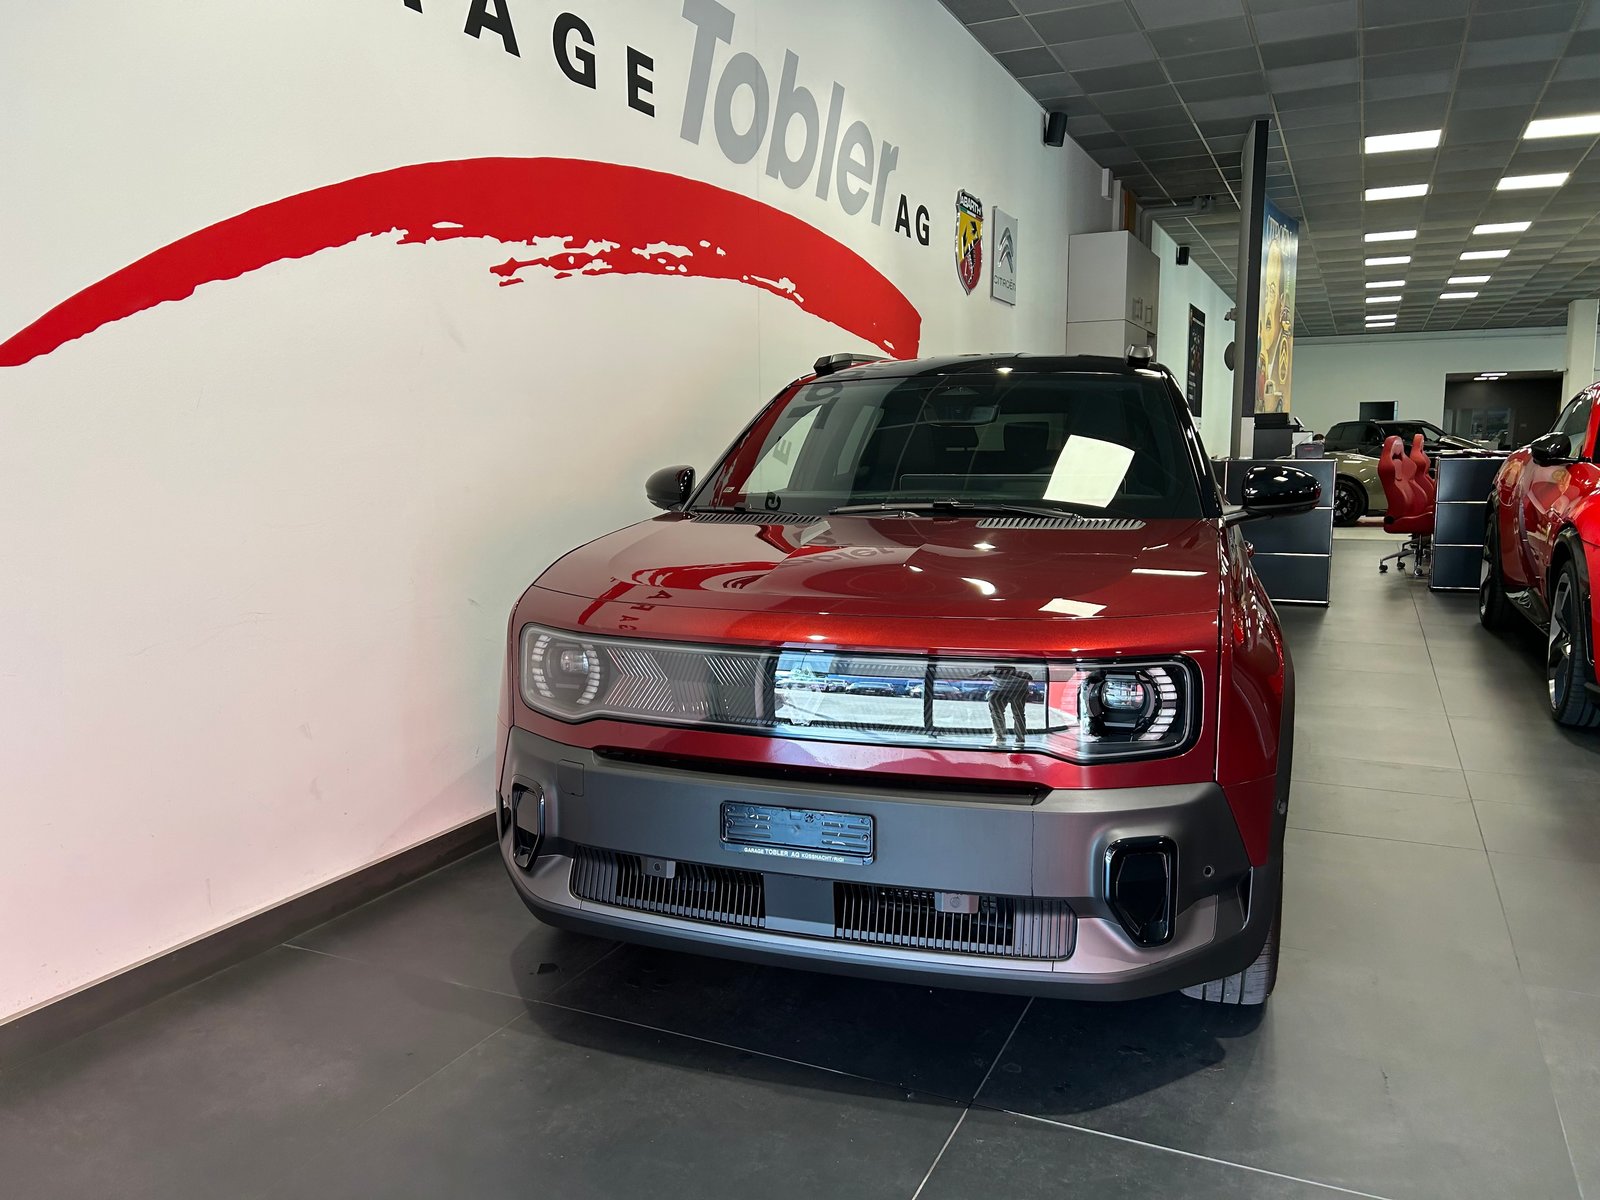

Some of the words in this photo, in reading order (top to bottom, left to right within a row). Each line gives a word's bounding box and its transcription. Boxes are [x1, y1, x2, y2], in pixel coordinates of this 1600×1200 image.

[404, 0, 656, 118] AGE
[680, 0, 900, 226] Tobler
[895, 193, 932, 247] AG
[960, 195, 982, 215] ABARTH
[744, 847, 764, 855] GARAGE
[765, 848, 789, 857] TOBLER
